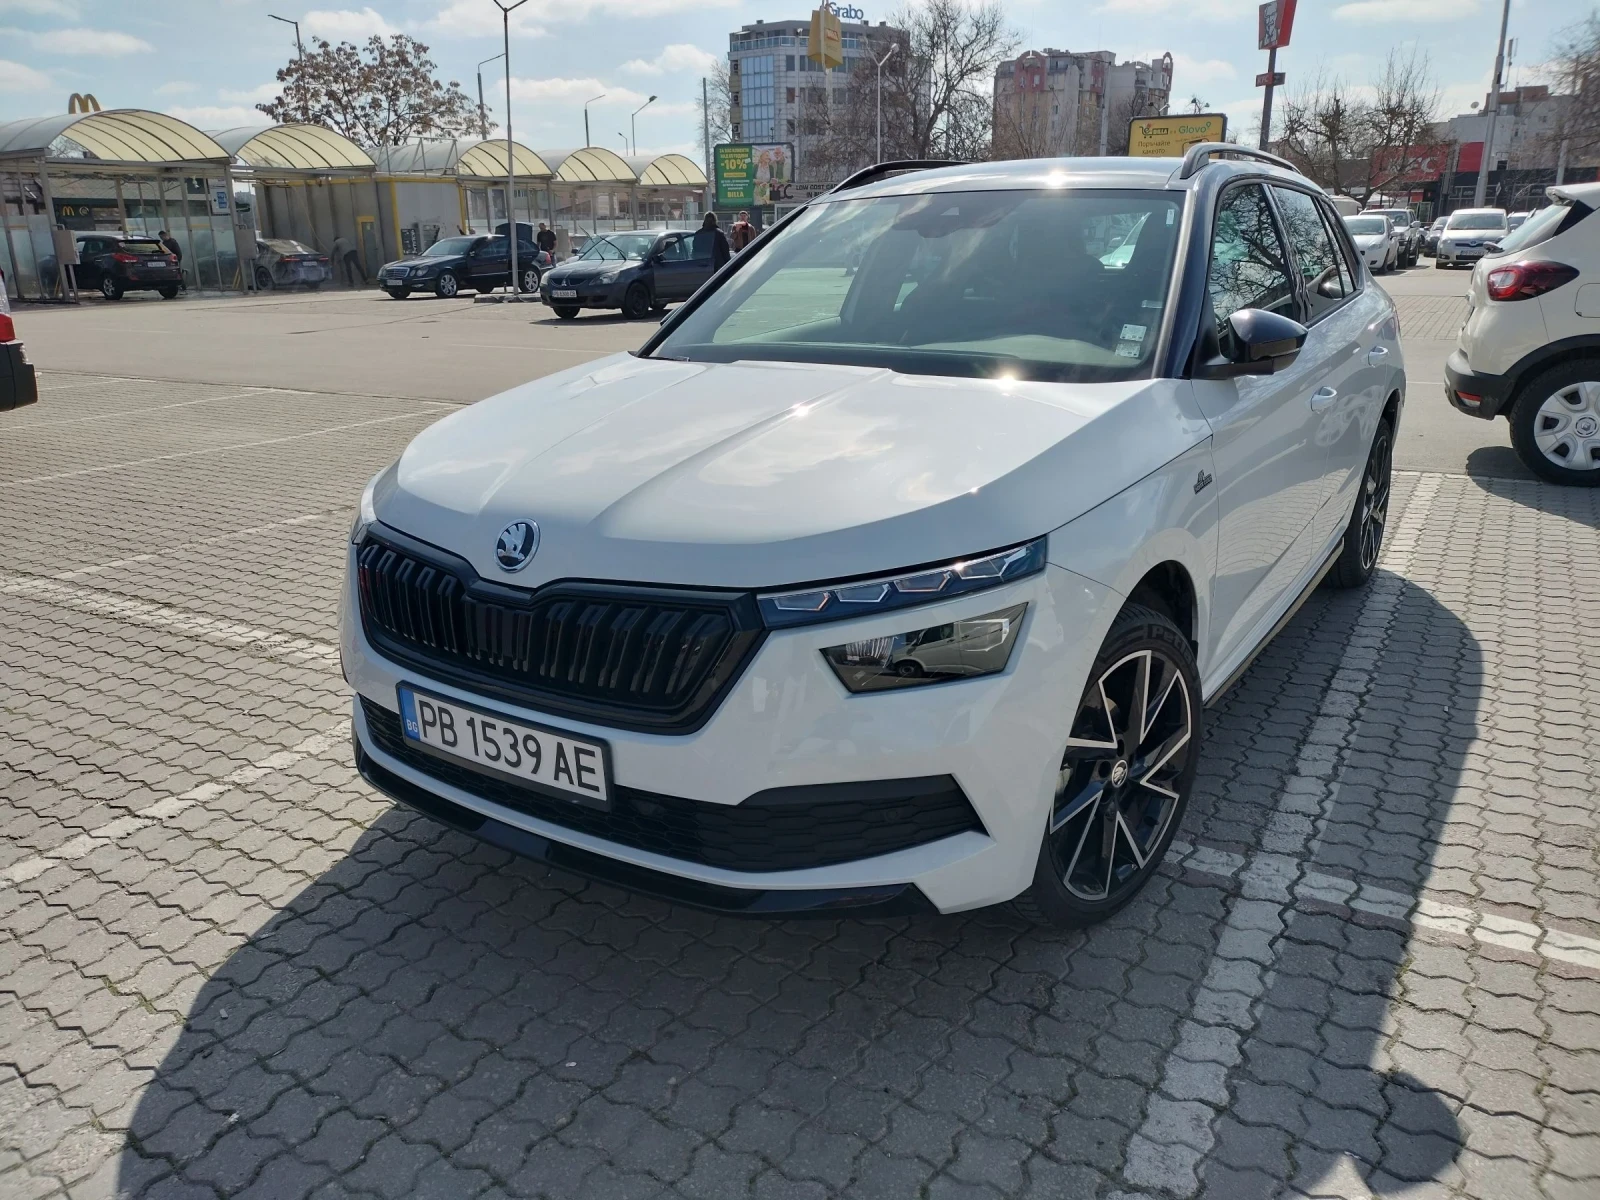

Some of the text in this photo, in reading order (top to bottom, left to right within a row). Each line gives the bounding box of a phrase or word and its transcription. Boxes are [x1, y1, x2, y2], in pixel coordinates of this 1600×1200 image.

[829, 2, 864, 20] Grabo
[1178, 125, 1206, 134] Glovo
[1137, 140, 1171, 148] Поръчайте
[720, 159, 747, 169] -10%
[1387, 157, 1439, 173] KFC
[406, 699, 601, 793] BG PB 1539 AE
